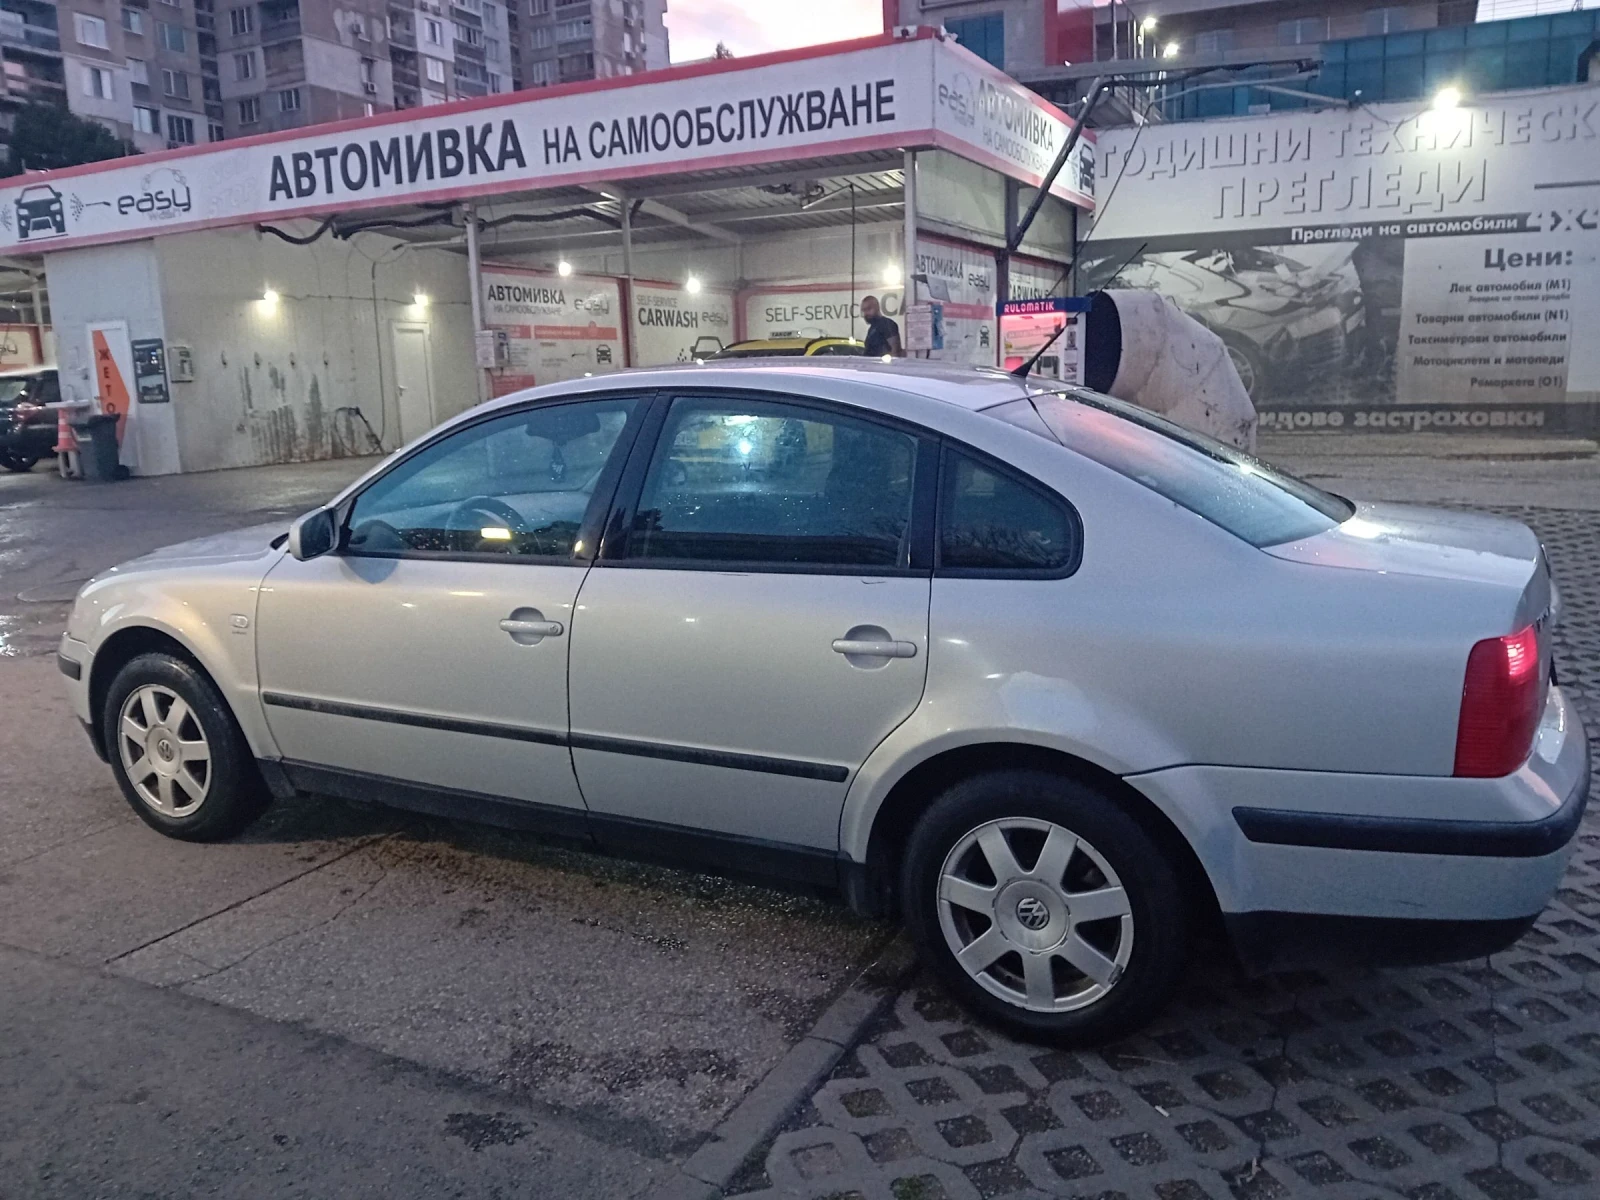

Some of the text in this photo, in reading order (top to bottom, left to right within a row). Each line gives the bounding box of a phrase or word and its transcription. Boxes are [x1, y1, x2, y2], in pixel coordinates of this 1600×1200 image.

[976, 78, 1054, 153] АВТОМИВКА
[268, 118, 527, 201] АВТОМИВКА
[543, 126, 581, 164] НА
[589, 79, 895, 159] САМООБСЛУЖВАНЕ
[1099, 127, 1311, 180] ГОДИШНИ
[118, 186, 191, 215] easy
[1213, 159, 1488, 220] ПРЕГЛЕДИ
[1291, 225, 1373, 243] Прегледи
[1379, 223, 1401, 236] на
[1407, 216, 1518, 235] автомобили
[1484, 248, 1573, 271] Цени:
[487, 283, 566, 305] АВТОМИВКА
[1449, 282, 1472, 293] Лек
[1476, 281, 1542, 293] автомобил
[638, 307, 699, 328] CARWASH
[1416, 313, 1464, 325] Товарни
[1468, 310, 1541, 322] автомобили
[1493, 331, 1567, 343] автомобили
[1413, 356, 1490, 367] Мотоциклети
[1505, 355, 1565, 366] мотопеди
[1257, 409, 1545, 430] идове застраховки
